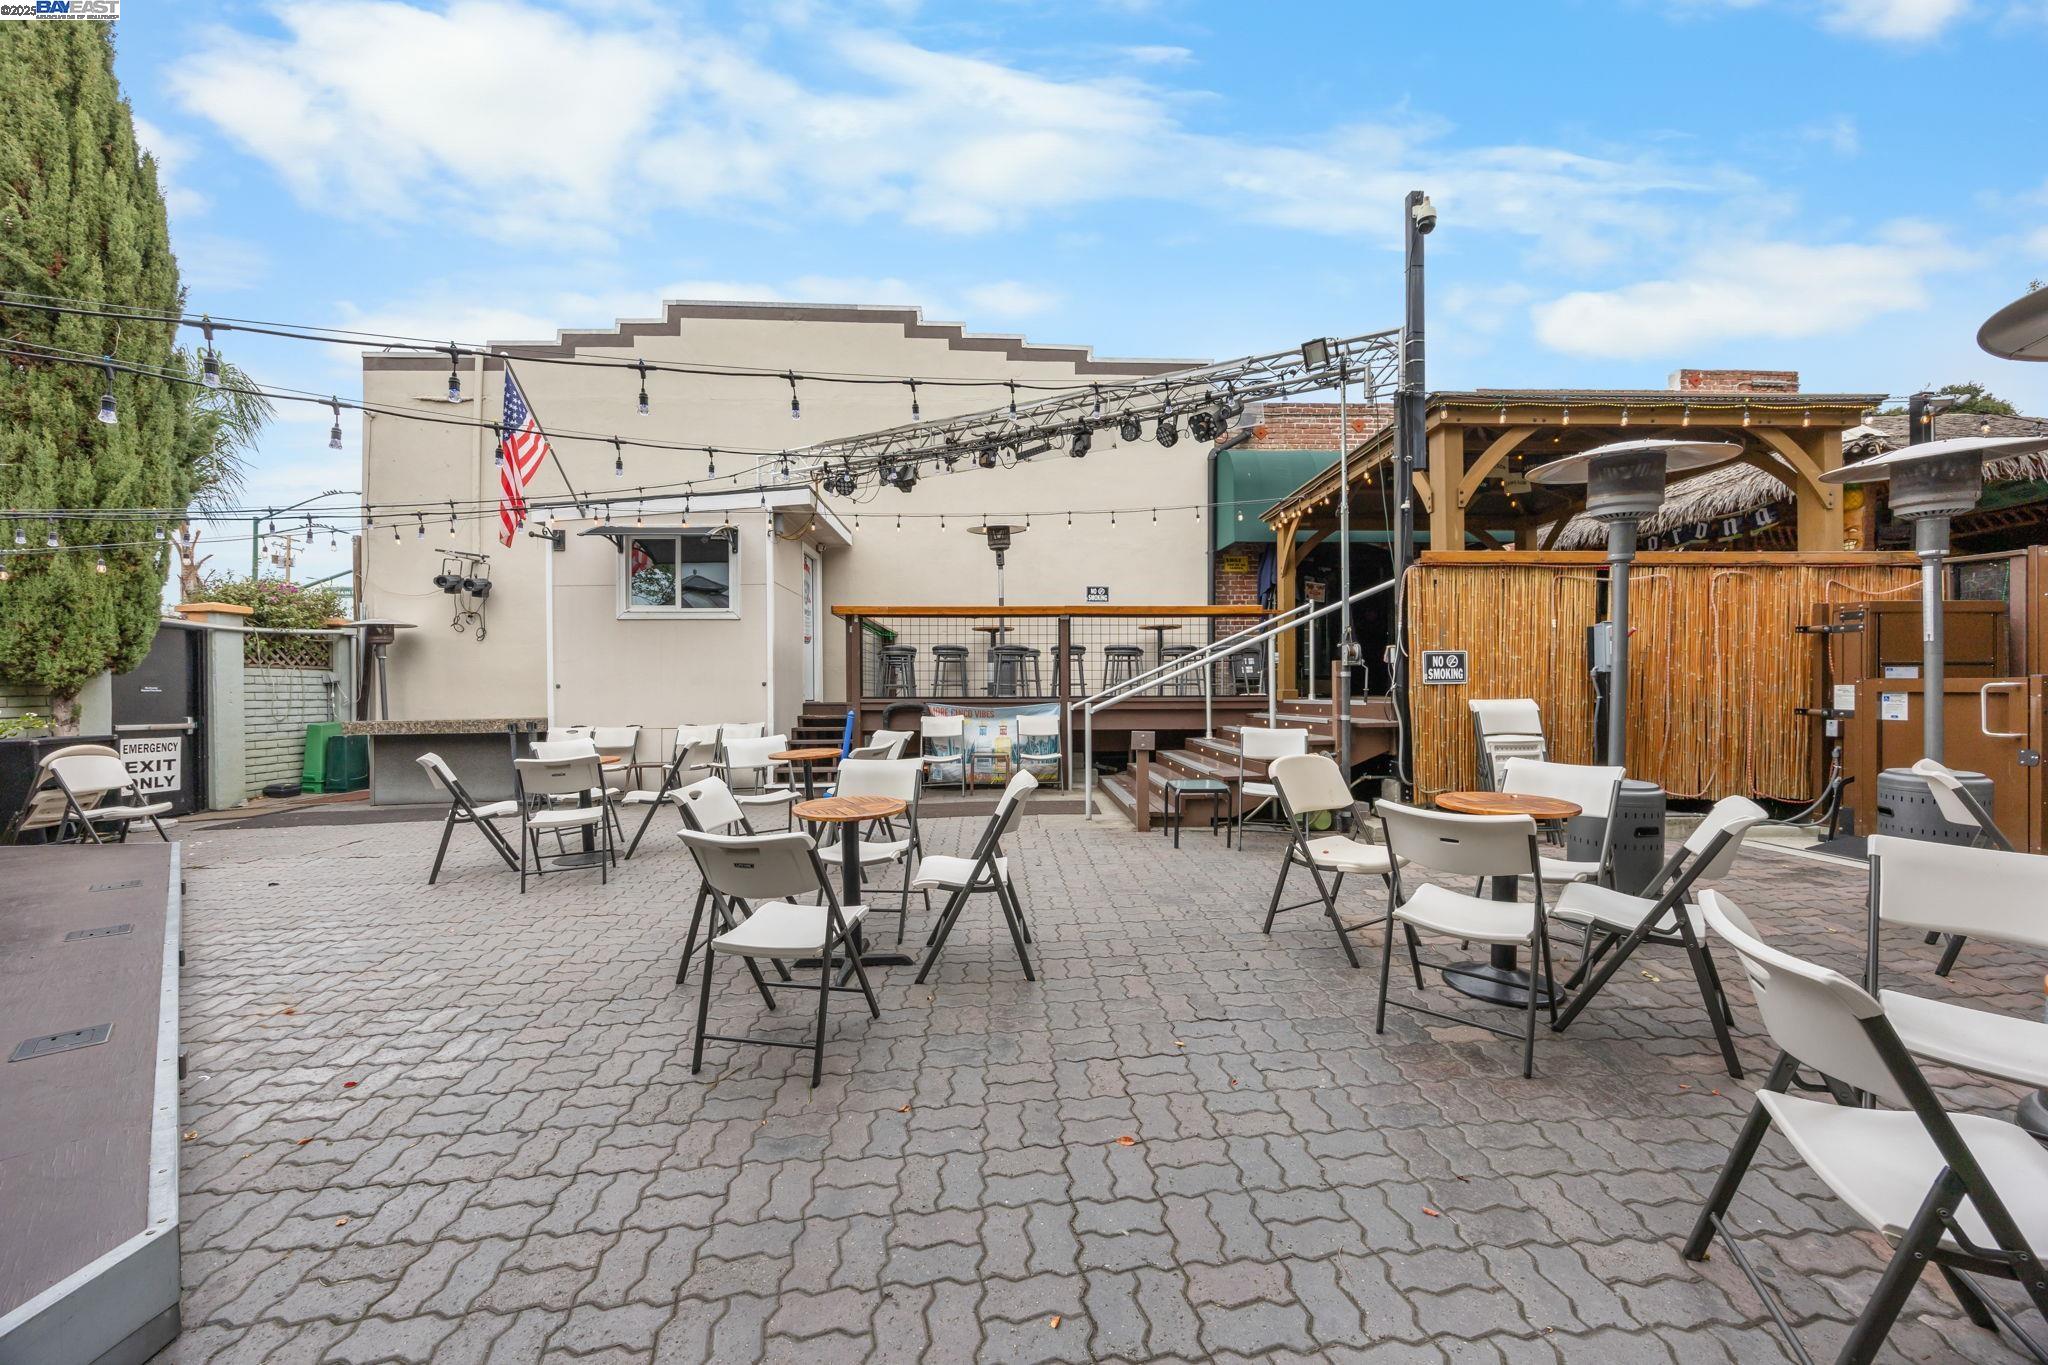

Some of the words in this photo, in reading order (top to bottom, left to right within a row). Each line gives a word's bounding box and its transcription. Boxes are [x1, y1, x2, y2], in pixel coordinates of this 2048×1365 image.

[1432, 655, 1444, 667] NO
[1428, 668, 1463, 680] SMOKING
[975, 710, 995, 719] VIBES
[123, 742, 178, 755] EMERGENCY
[125, 759, 176, 774] EXIT
[126, 775, 175, 790] ONLY
